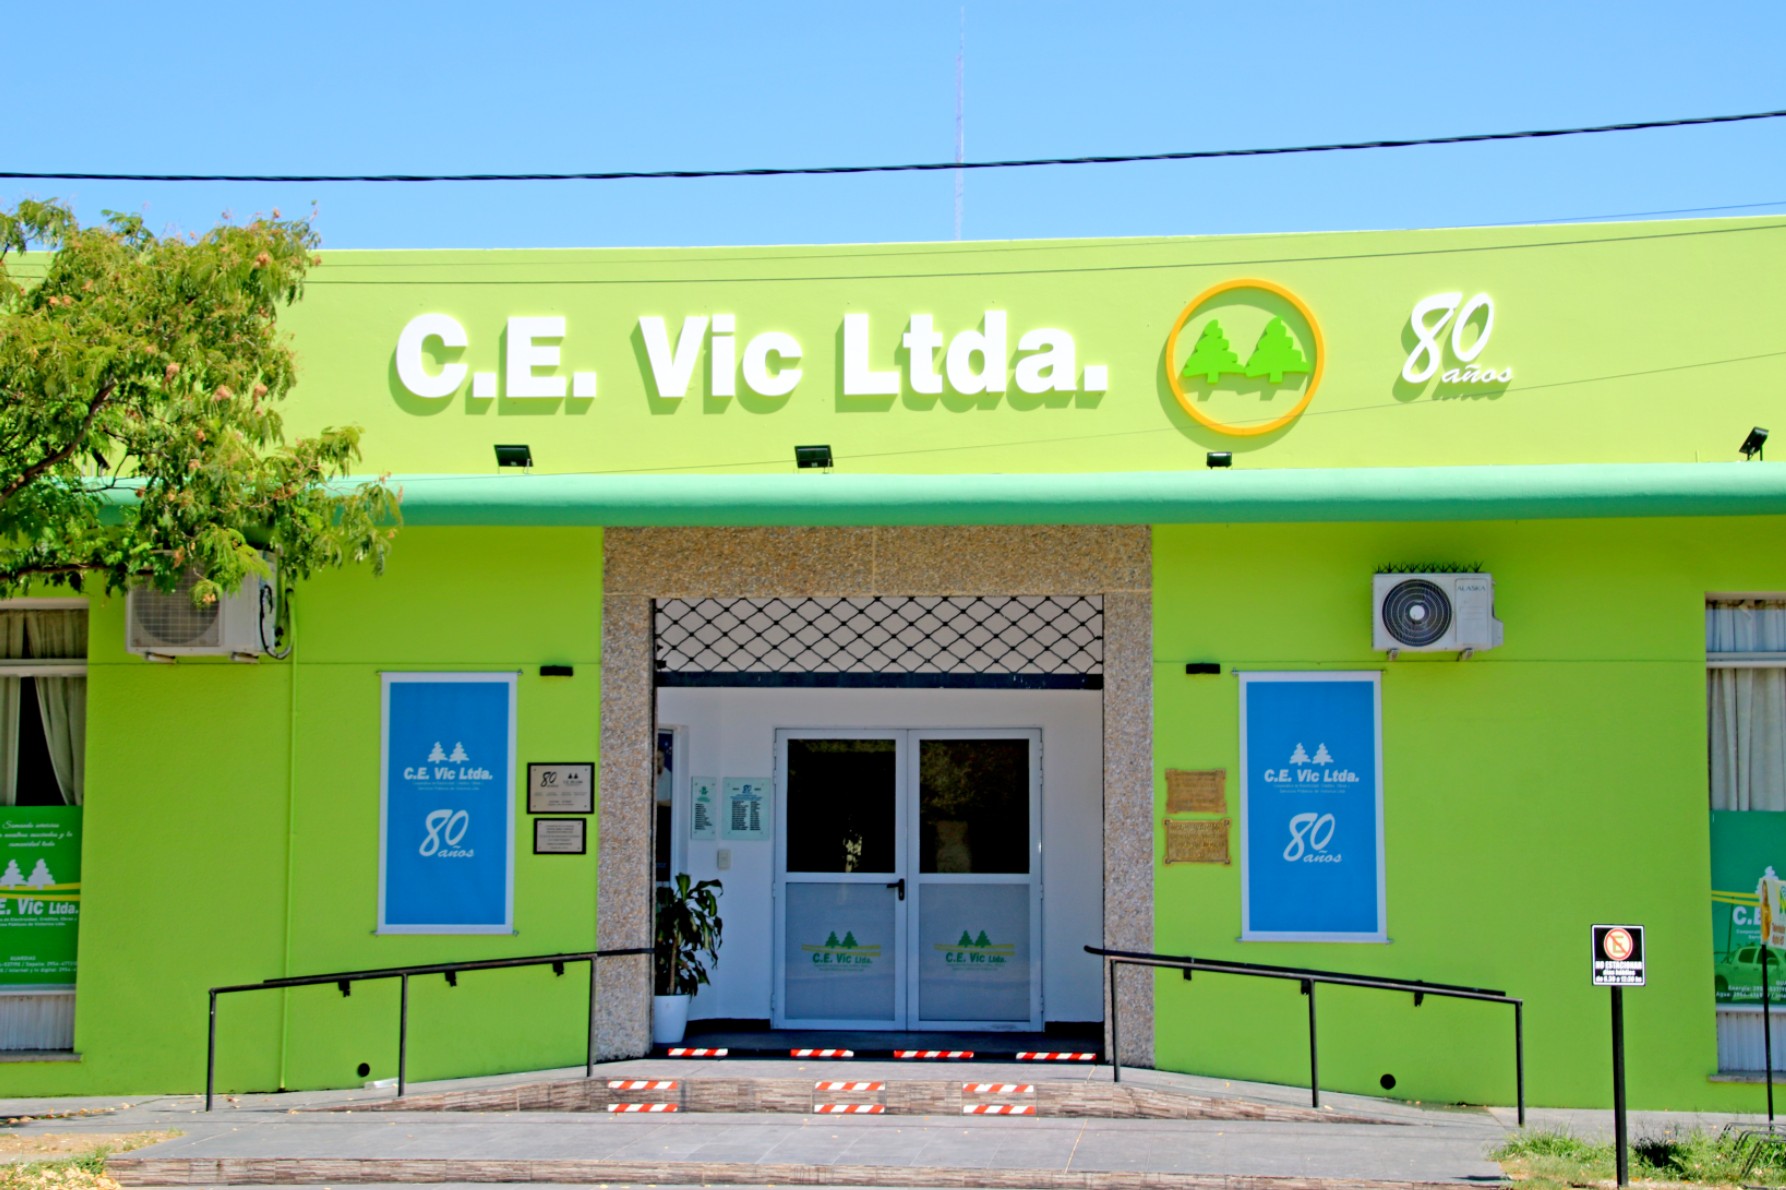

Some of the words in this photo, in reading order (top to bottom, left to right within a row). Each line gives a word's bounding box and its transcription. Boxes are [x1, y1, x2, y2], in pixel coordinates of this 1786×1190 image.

[1401, 291, 1494, 384] 80
[398, 312, 597, 398] C.E.
[639, 313, 803, 398] Vic
[844, 309, 1108, 396] Ltda.
[1441, 363, 1513, 384] años
[403, 767, 430, 780] C.E.
[434, 767, 456, 780] Vic
[459, 767, 493, 780] Ltda.
[540, 771, 557, 788] 80
[1264, 769, 1292, 782] C.E.
[1297, 769, 1320, 782] Vic
[1323, 769, 1360, 782] Ltda.
[418, 808, 469, 857] 80
[1282, 812, 1336, 862] 80
[438, 845, 475, 858] años
[1303, 850, 1342, 863] años
[17, 897, 44, 916] Vic
[48, 901, 79, 915] Ltda.
[812, 952, 833, 963] C.E.
[837, 952, 852, 963] Vic
[945, 951, 966, 963] C.E.
[969, 951, 985, 963] Vic
[1595, 961, 1604, 969] NO
